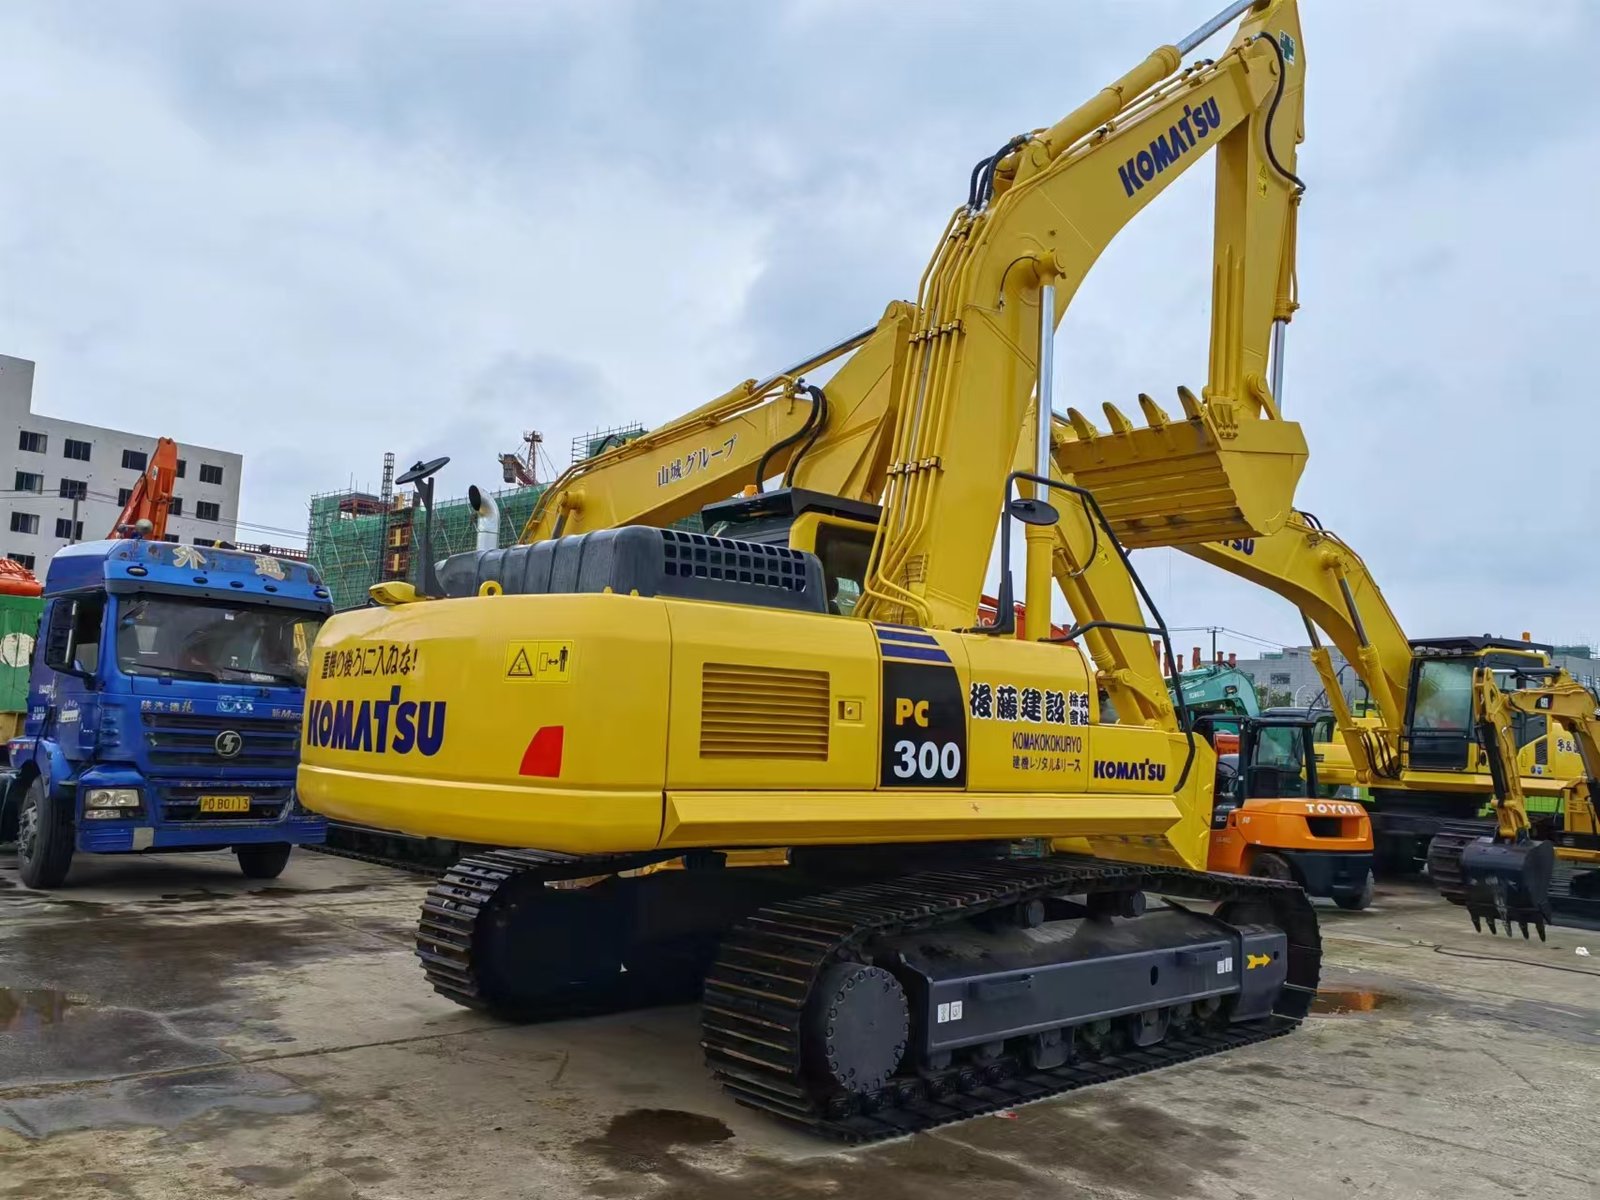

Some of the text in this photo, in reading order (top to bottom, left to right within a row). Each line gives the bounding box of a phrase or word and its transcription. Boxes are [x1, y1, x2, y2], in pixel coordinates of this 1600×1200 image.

[1117, 96, 1222, 198] KOMATSU
[657, 433, 738, 487] 山城グループ
[306, 685, 447, 756] KOMATSU
[896, 698, 929, 727] PC
[893, 740, 961, 779] 300
[1012, 732, 1082, 753] KOMAKOKOKURYO
[1094, 758, 1166, 781] KOMATSU
[1305, 803, 1361, 815] TOYOTA
